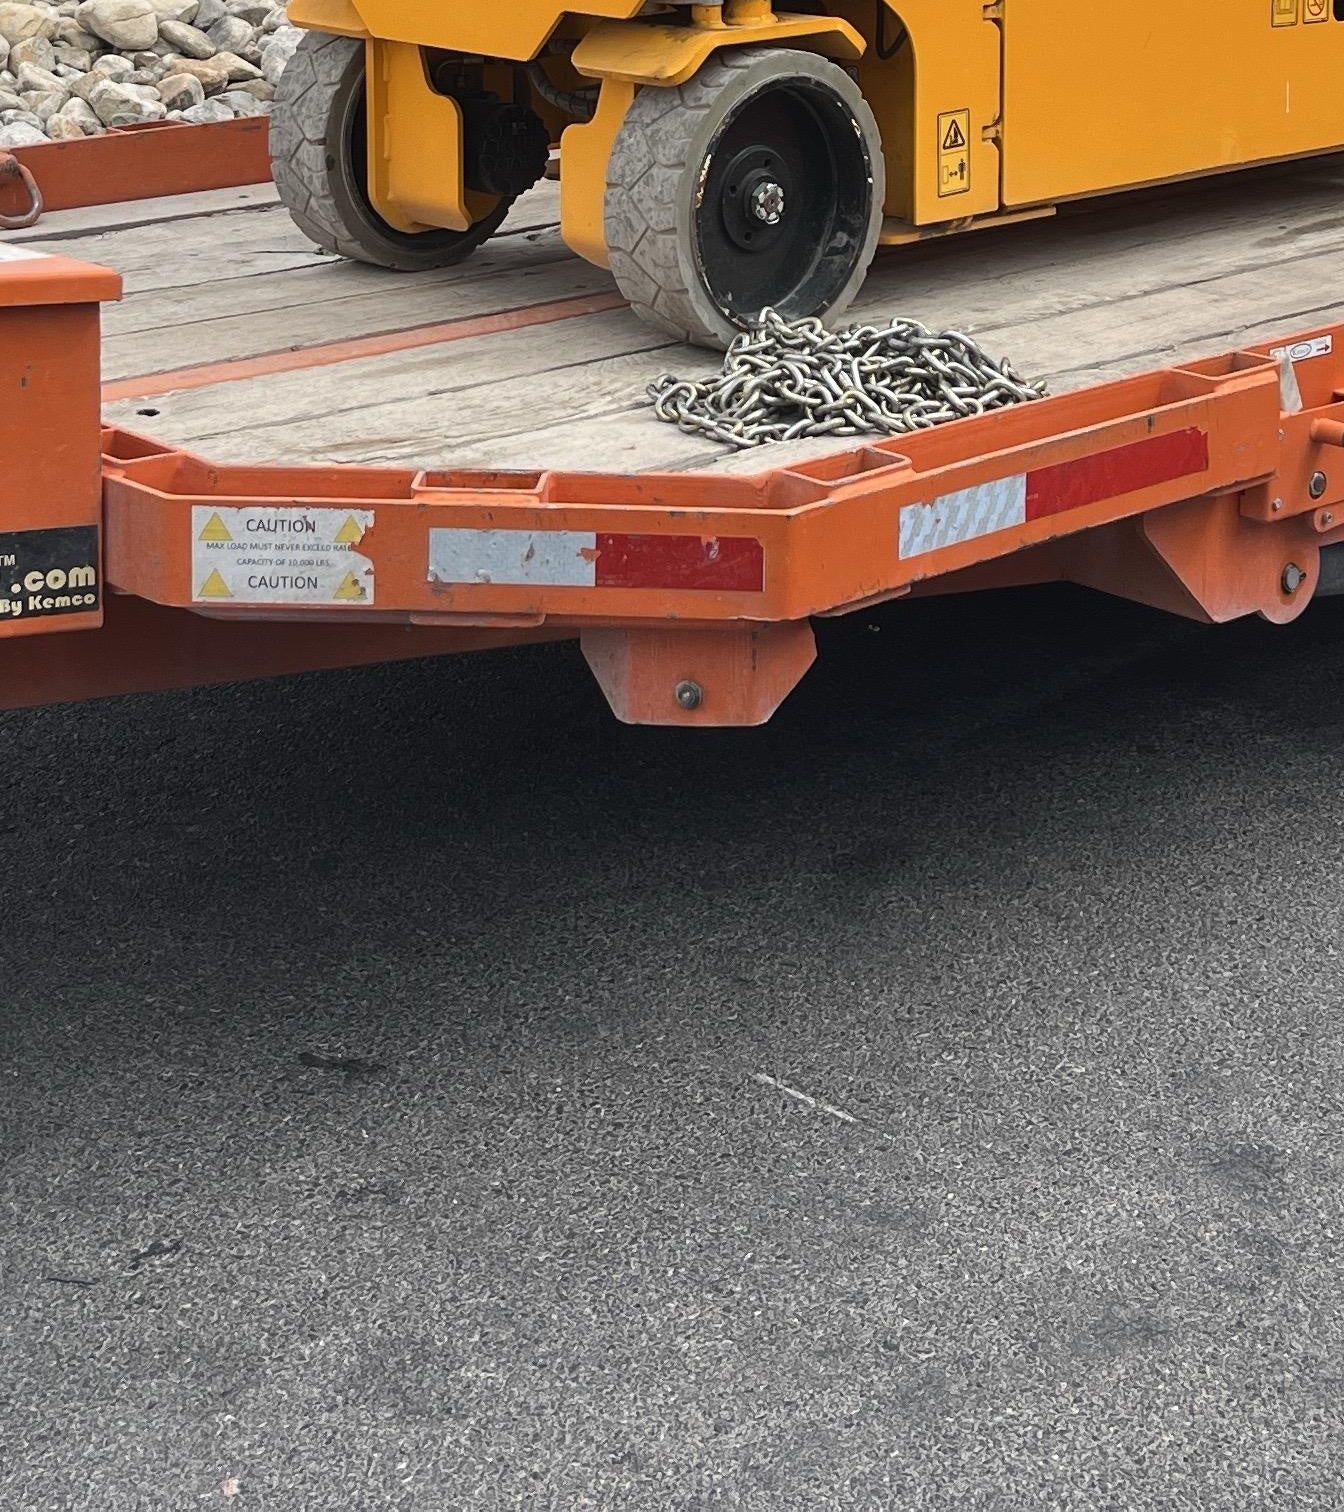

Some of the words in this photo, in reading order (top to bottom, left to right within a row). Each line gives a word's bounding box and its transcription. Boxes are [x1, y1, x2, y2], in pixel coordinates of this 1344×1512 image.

[246, 518, 316, 533] CAUTION
[206, 542, 224, 550] MAX
[226, 543, 247, 551] LOAD
[250, 543, 272, 551] MUST
[274, 543, 300, 551] NEVER
[237, 558, 273, 566] CAPACITY
[275, 558, 286, 566] OF
[248, 575, 318, 589] CAUTION
[28, 592, 96, 609] Kemco
